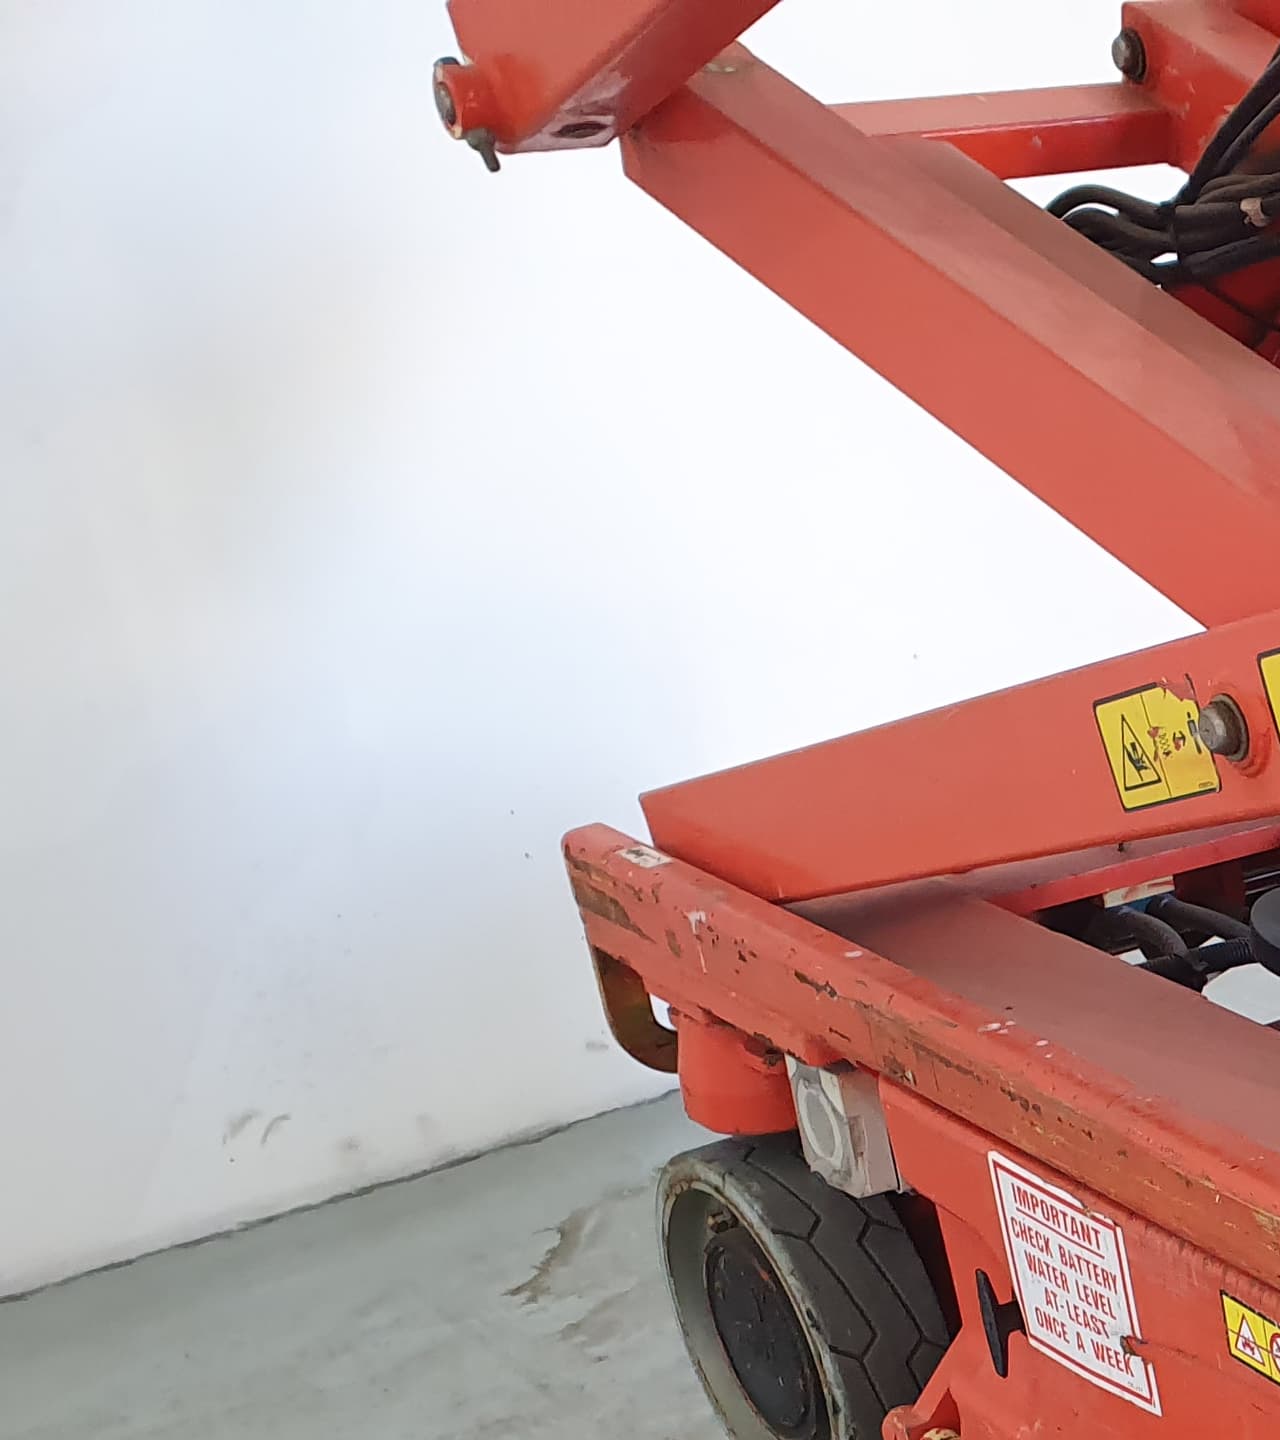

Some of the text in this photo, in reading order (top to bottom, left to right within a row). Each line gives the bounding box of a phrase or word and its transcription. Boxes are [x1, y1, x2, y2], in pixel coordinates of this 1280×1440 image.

[1010, 1182, 1101, 1250] IMPORTANT
[1010, 1216, 1119, 1295] CHECK BATTERY
[1024, 1250, 1117, 1320] WATER LEVEL
[1035, 1306, 1135, 1378] ONCE A WEEK
[1045, 1286, 1110, 1339] AT-LEAST
